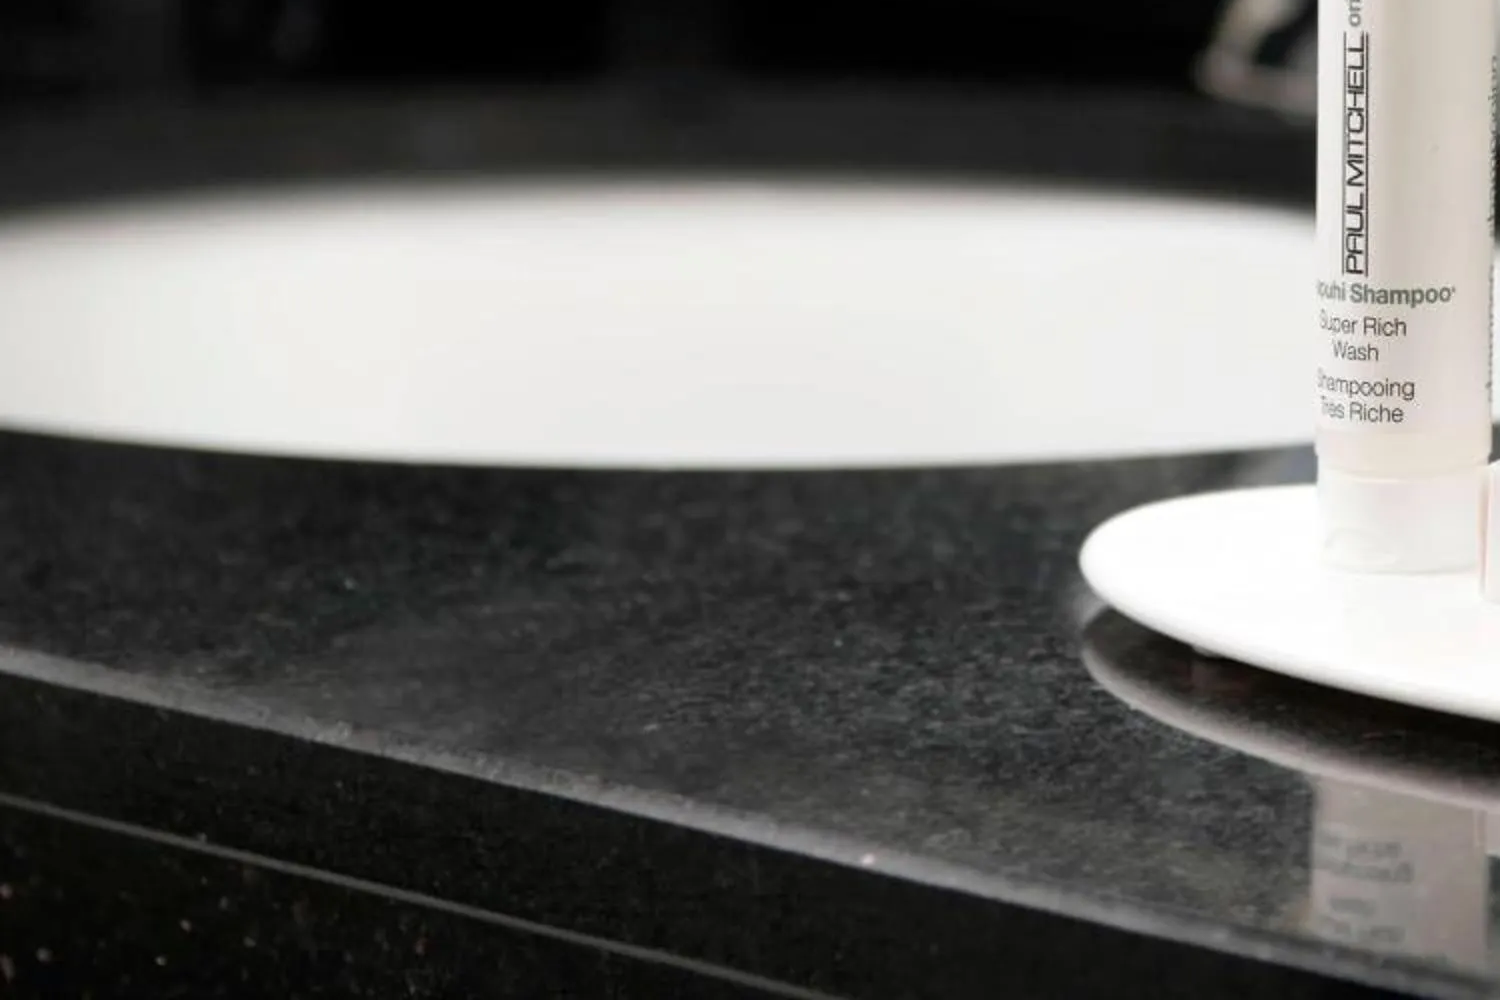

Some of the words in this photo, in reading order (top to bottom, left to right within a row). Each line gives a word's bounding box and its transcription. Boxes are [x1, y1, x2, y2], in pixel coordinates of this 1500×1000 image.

[1346, 31, 1365, 187] MITCHELL
[1345, 195, 1364, 276] PAUL
[1319, 308, 1358, 335] Super
[1363, 316, 1407, 337] Rich
[1332, 339, 1379, 361] Wash
[1349, 401, 1404, 423] Riche
